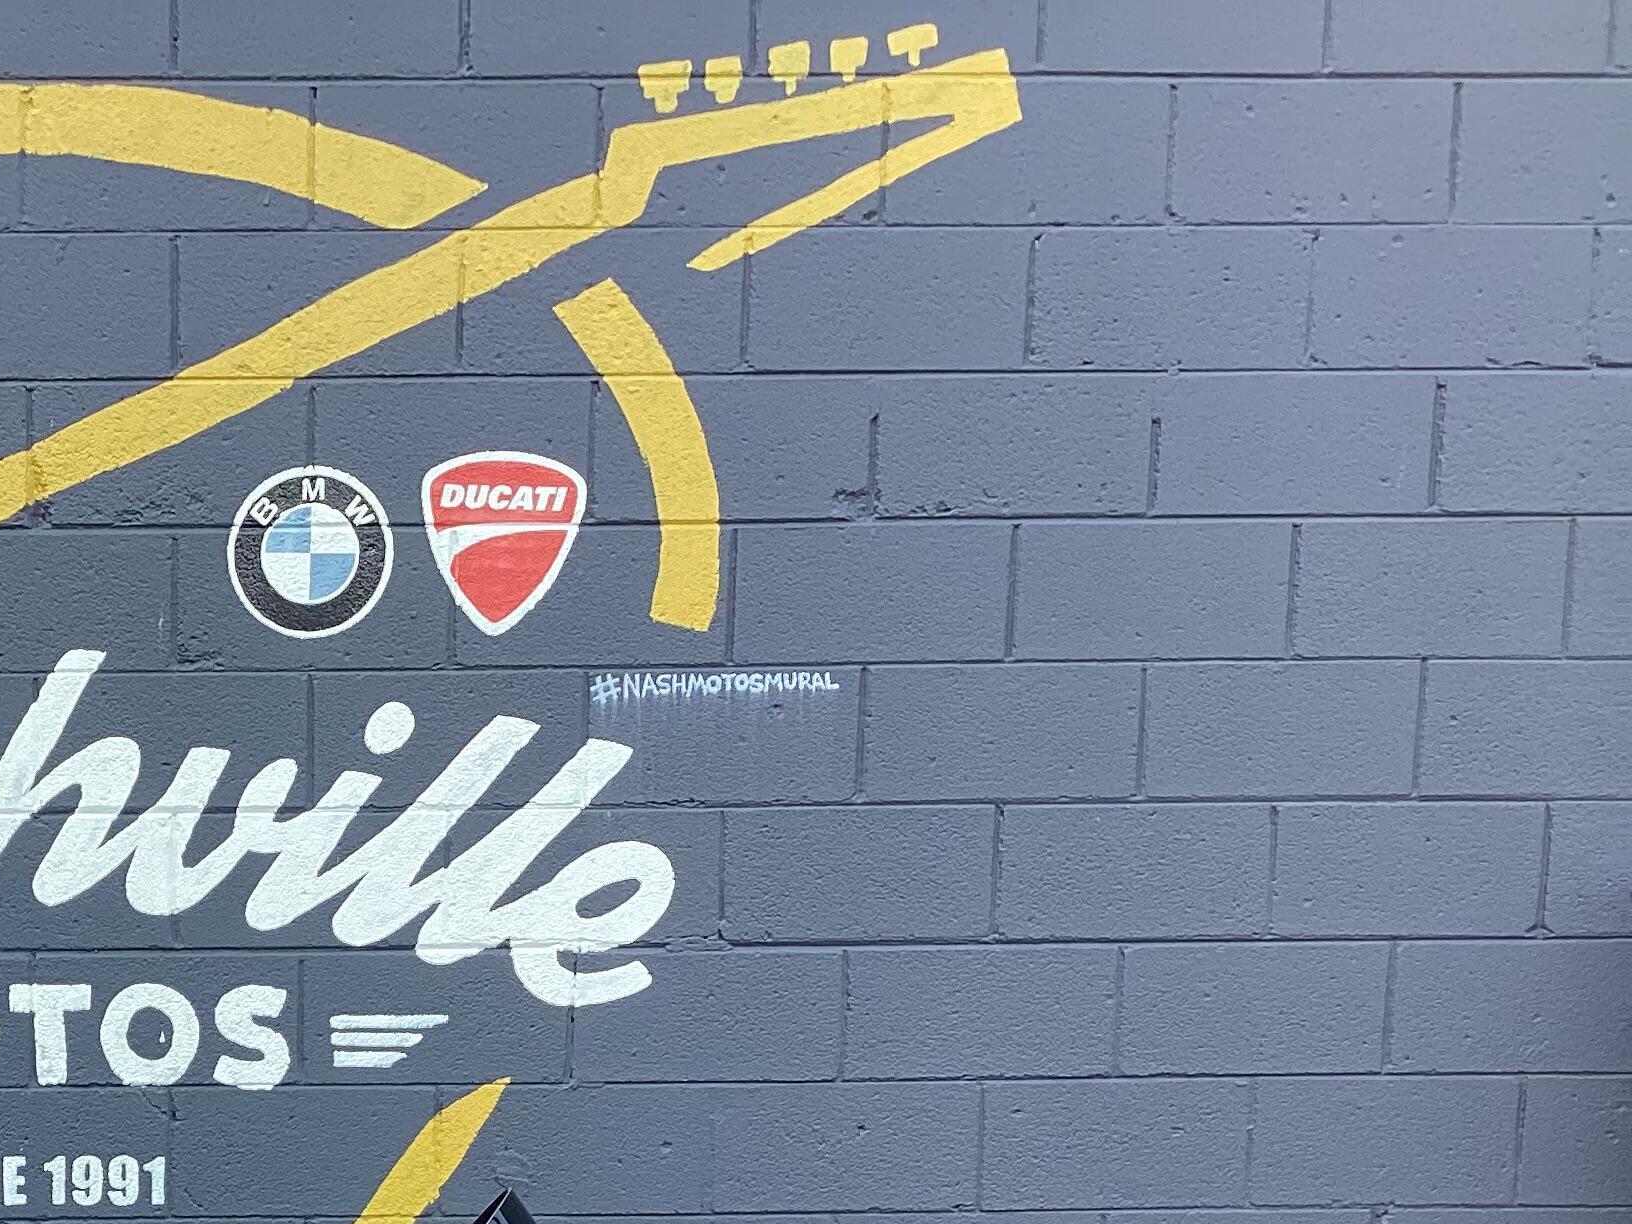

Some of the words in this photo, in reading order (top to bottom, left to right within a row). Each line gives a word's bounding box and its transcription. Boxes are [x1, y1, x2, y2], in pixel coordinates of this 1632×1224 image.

[249, 477, 376, 527] BMW
[439, 483, 569, 512] DUCATI
[590, 671, 840, 704] #NASHMOTOSMURAL
[43, 1154, 166, 1207] 1991
